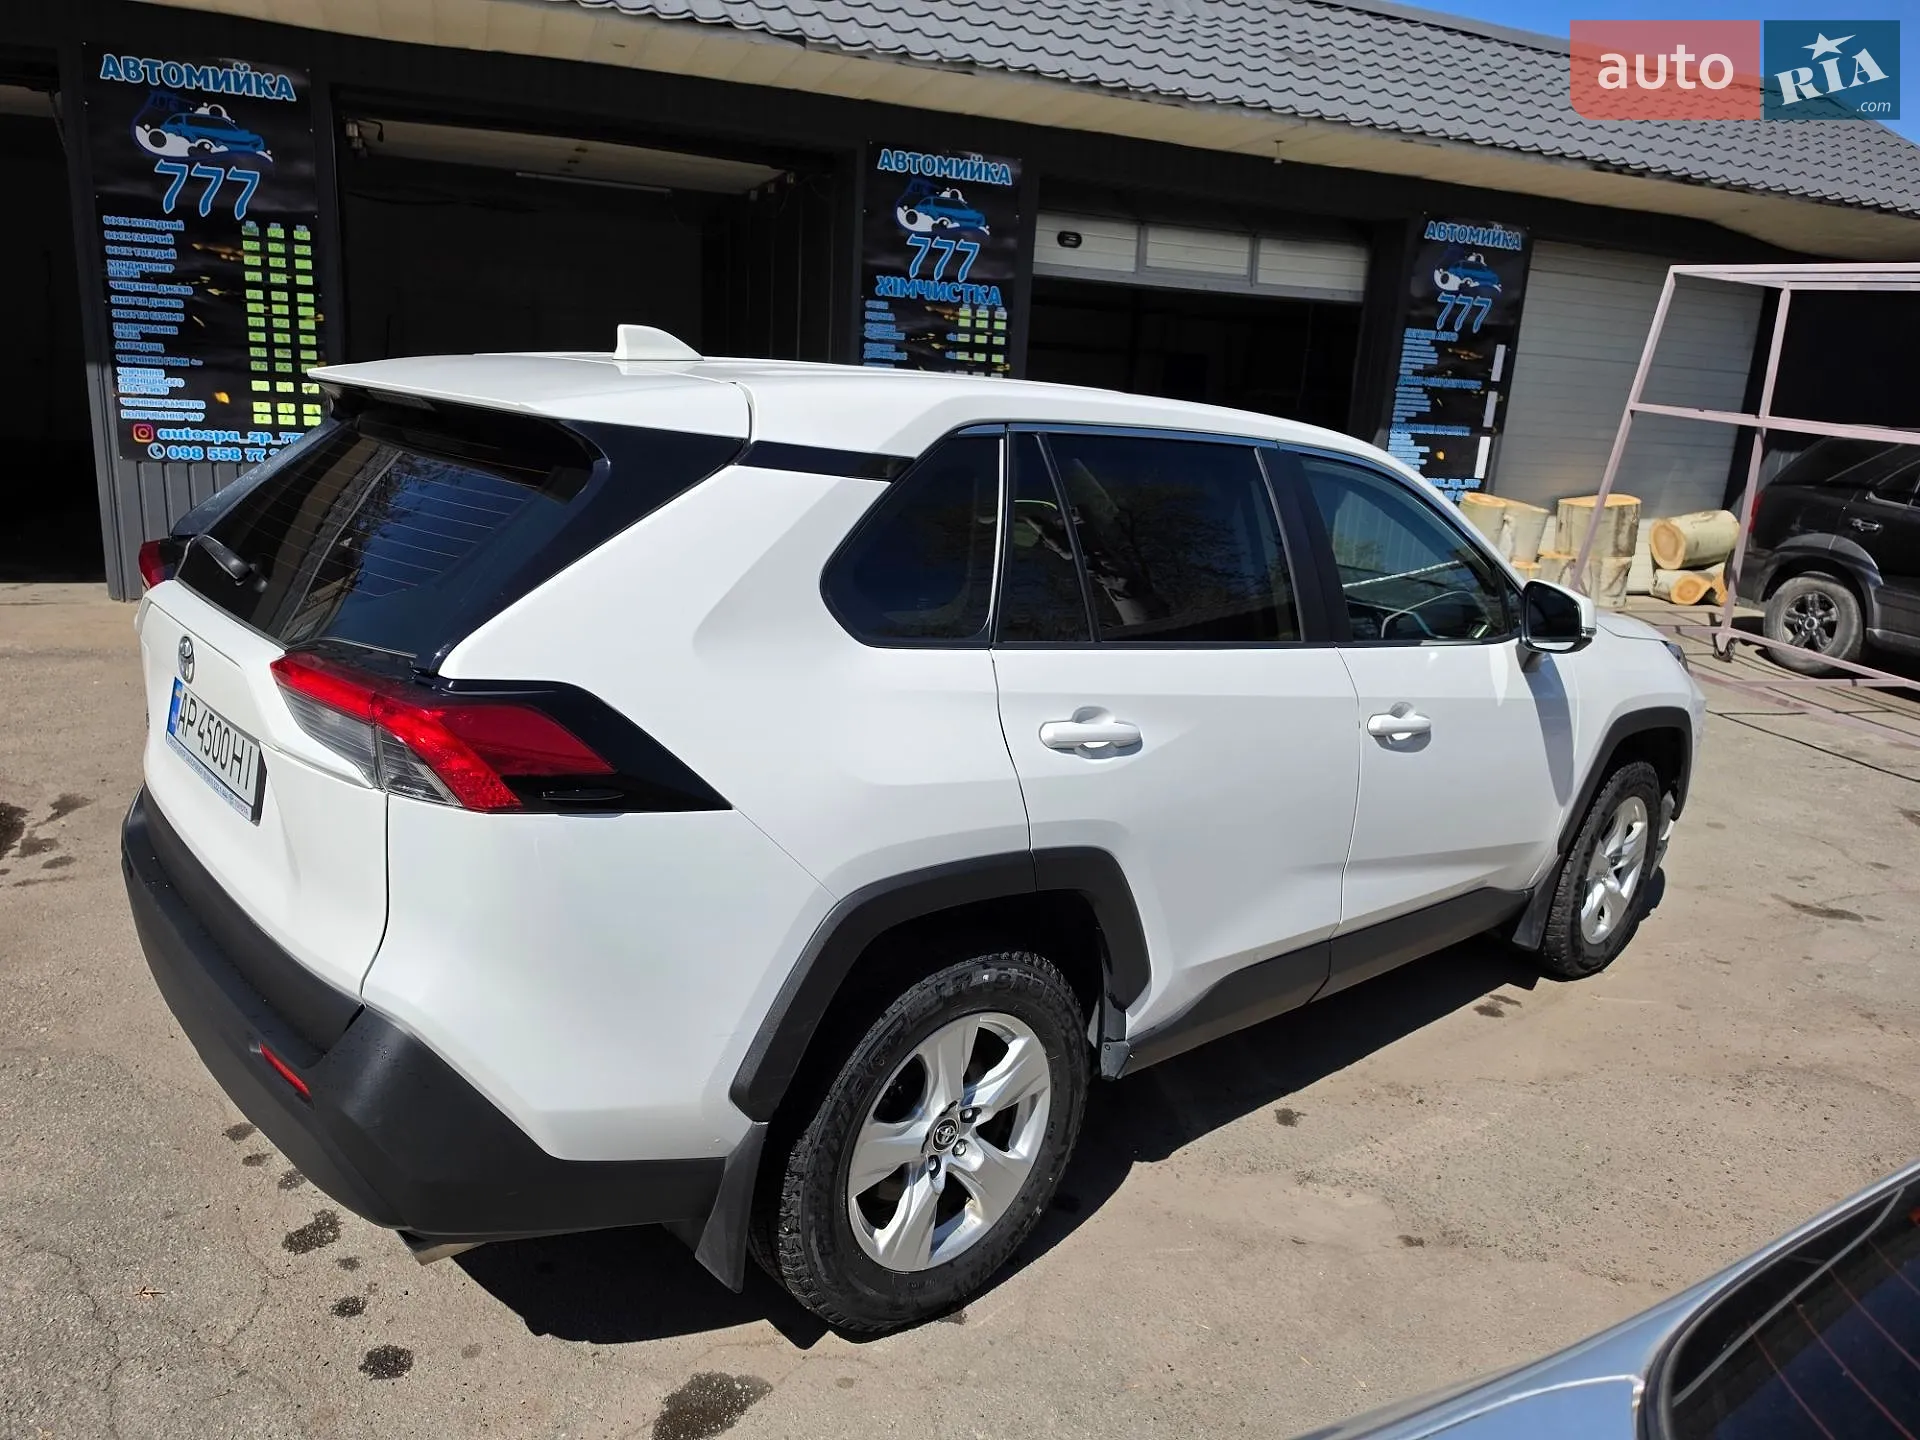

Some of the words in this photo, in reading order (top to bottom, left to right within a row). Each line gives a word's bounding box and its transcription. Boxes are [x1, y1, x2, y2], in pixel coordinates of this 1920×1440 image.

[100, 53, 297, 102] АВТОМИЙКА
[877, 147, 1013, 186] АВТОМИЙКА
[154, 159, 260, 221] 777
[1424, 220, 1522, 250] АВТОМИЙКА
[906, 233, 981, 283] 777
[874, 275, 1003, 307] ХІМЧИСТКА
[1436, 291, 1492, 334] 777
[167, 446, 203, 460] 098
[207, 447, 243, 462] 558
[244, 449, 267, 463] 77
[176, 693, 198, 738] AP
[197, 709, 231, 770] 4500
[230, 733, 253, 790] HI
